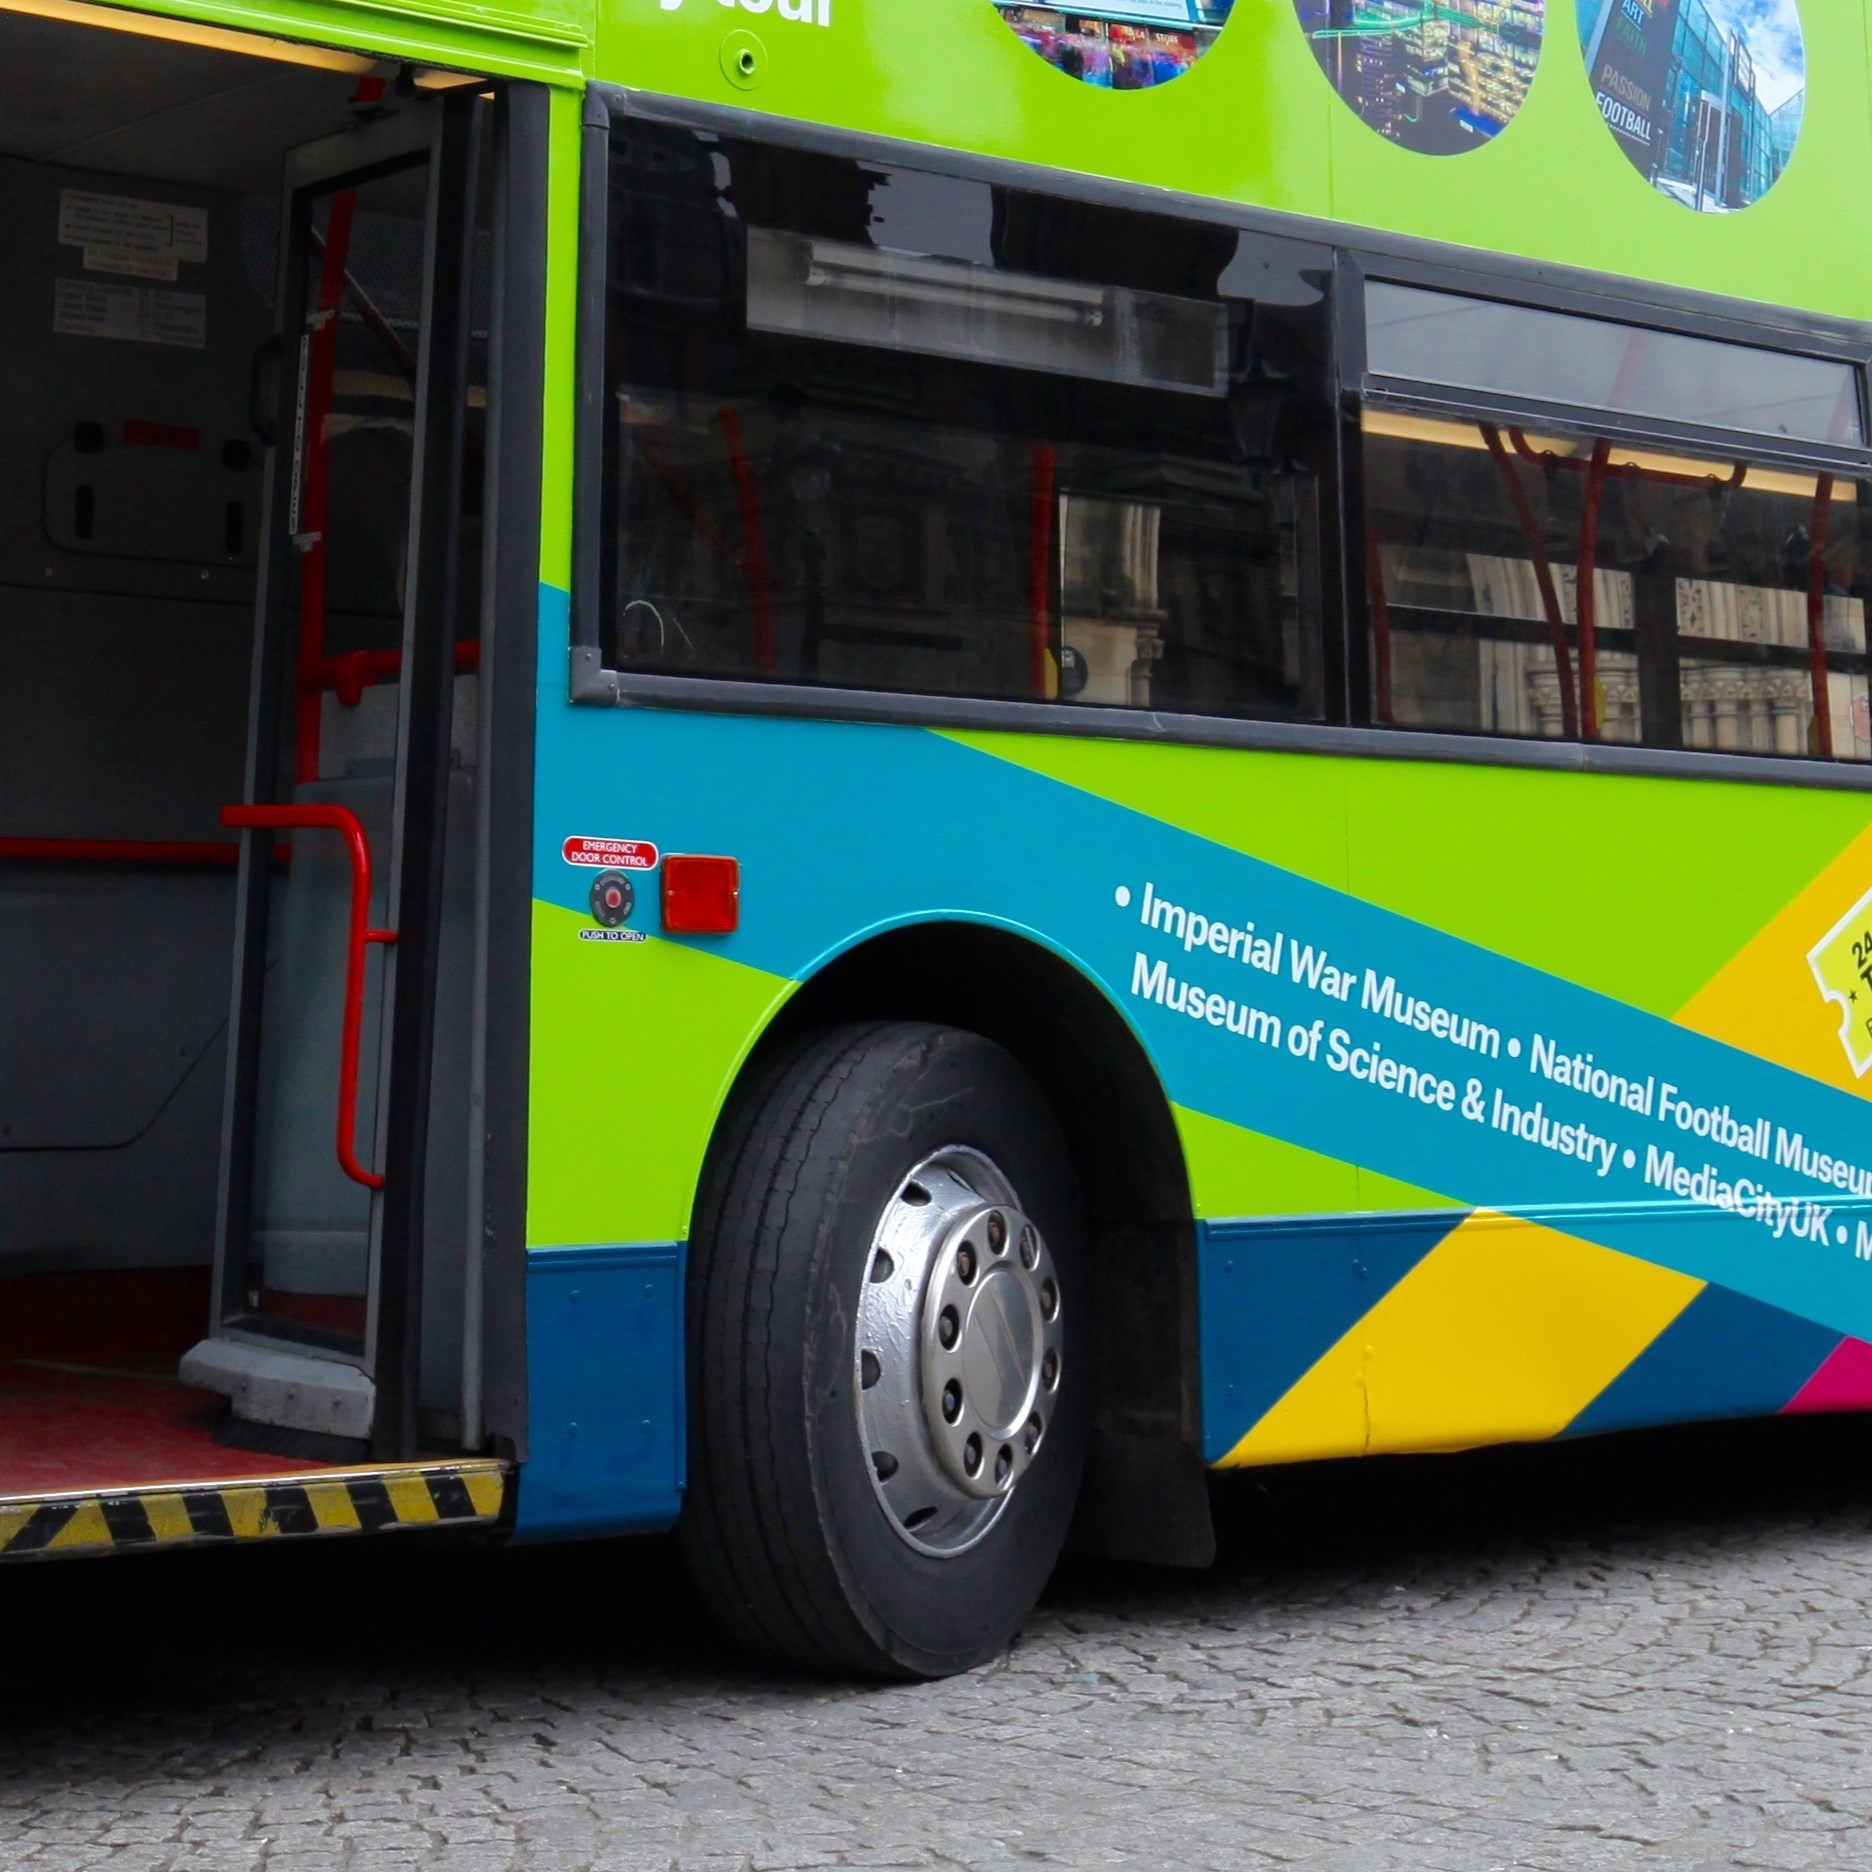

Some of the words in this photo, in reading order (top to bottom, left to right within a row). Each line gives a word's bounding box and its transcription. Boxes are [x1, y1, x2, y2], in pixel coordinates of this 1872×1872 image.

[1601, 63, 1652, 112] PASSION
[1596, 90, 1651, 141] FOOTBALL
[571, 851, 601, 863] DOOR
[602, 854, 648, 866] CONTROL
[582, 840, 638, 854] EMERGENCY
[582, 930, 604, 939] PUSH
[606, 931, 618, 939] TO
[620, 932, 644, 941] OPEN
[1140, 881, 1284, 976] Imperial
[1290, 939, 1357, 1003] War
[1360, 968, 1501, 1059] Museum
[1529, 1033, 1655, 1117] National
[1658, 1082, 1771, 1160] Football
[1131, 951, 1281, 1049] Museum
[1287, 1020, 1325, 1062] of
[1325, 1028, 1457, 1112] Science
[1461, 1077, 1486, 1123] &
[1492, 1088, 1618, 1177] Industry
[1644, 1144, 1834, 1246] MediaCityUK
